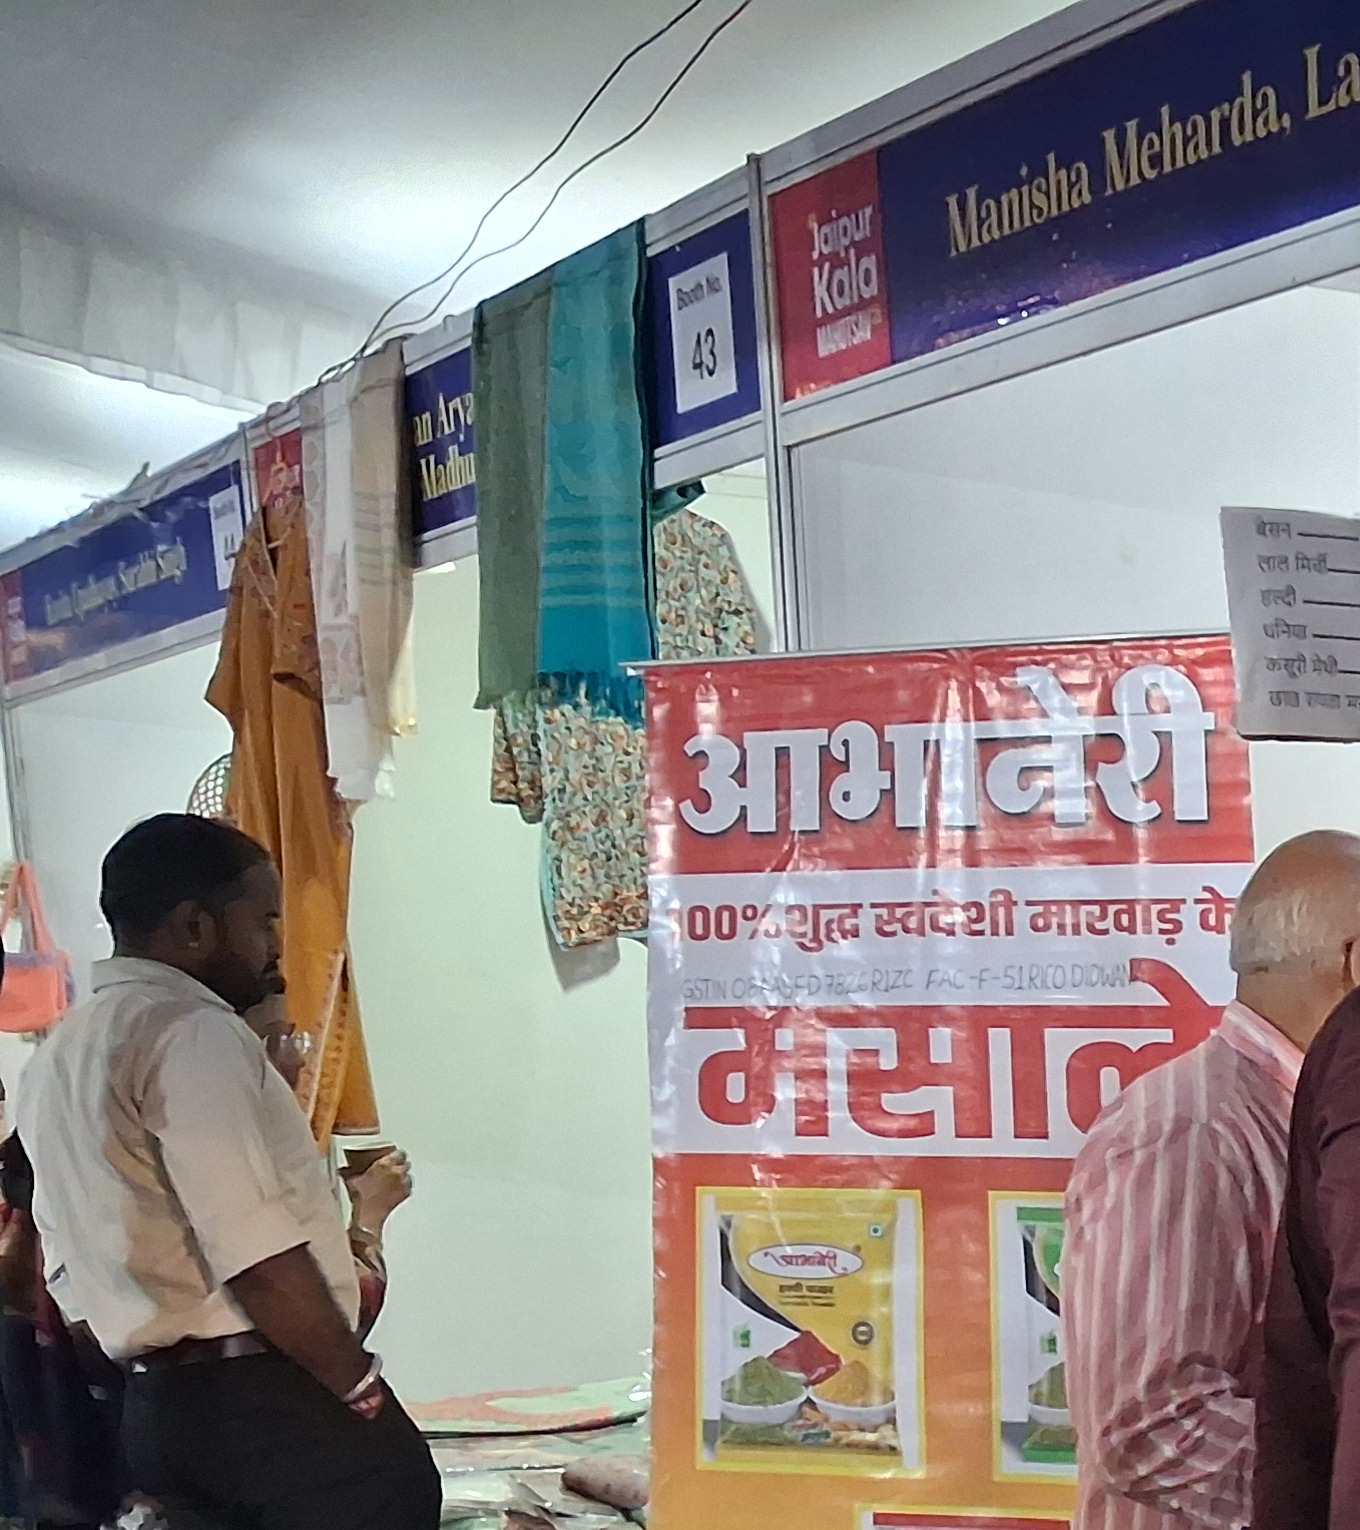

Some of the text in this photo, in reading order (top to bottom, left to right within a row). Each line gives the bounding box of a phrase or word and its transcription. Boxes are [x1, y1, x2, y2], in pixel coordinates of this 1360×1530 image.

[944, 152, 1092, 259] Manisha
[1100, 70, 1294, 195] Meharda,
[812, 205, 873, 260] Jaipur
[813, 247, 879, 318] Kala
[692, 327, 717, 380] 43
[679, 664, 1214, 835] आभानेरी
[1025, 899, 1185, 945] मारवाड़
